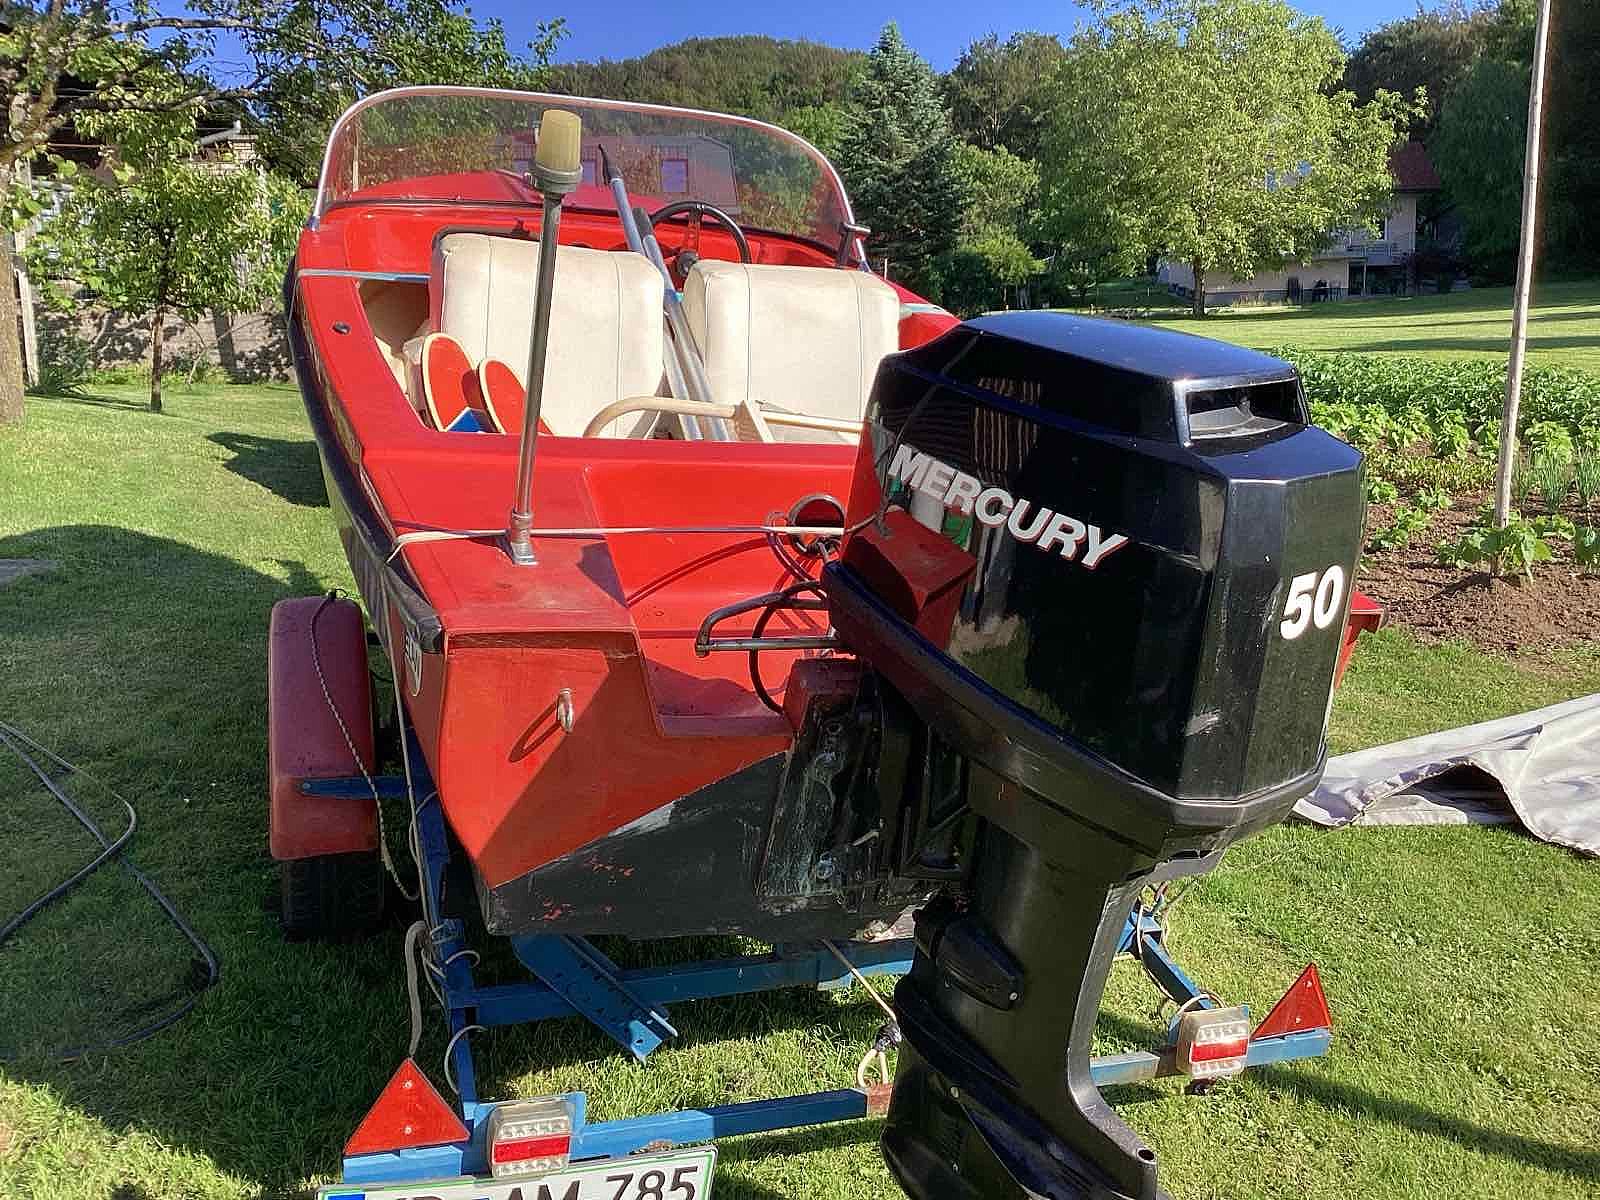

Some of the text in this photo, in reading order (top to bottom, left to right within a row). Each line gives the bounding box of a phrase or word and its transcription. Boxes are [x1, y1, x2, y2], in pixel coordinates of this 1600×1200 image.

[888, 444, 1128, 569] MERCURY
[1280, 565, 1344, 640] 50
[606, 1166, 698, 1200] 785
